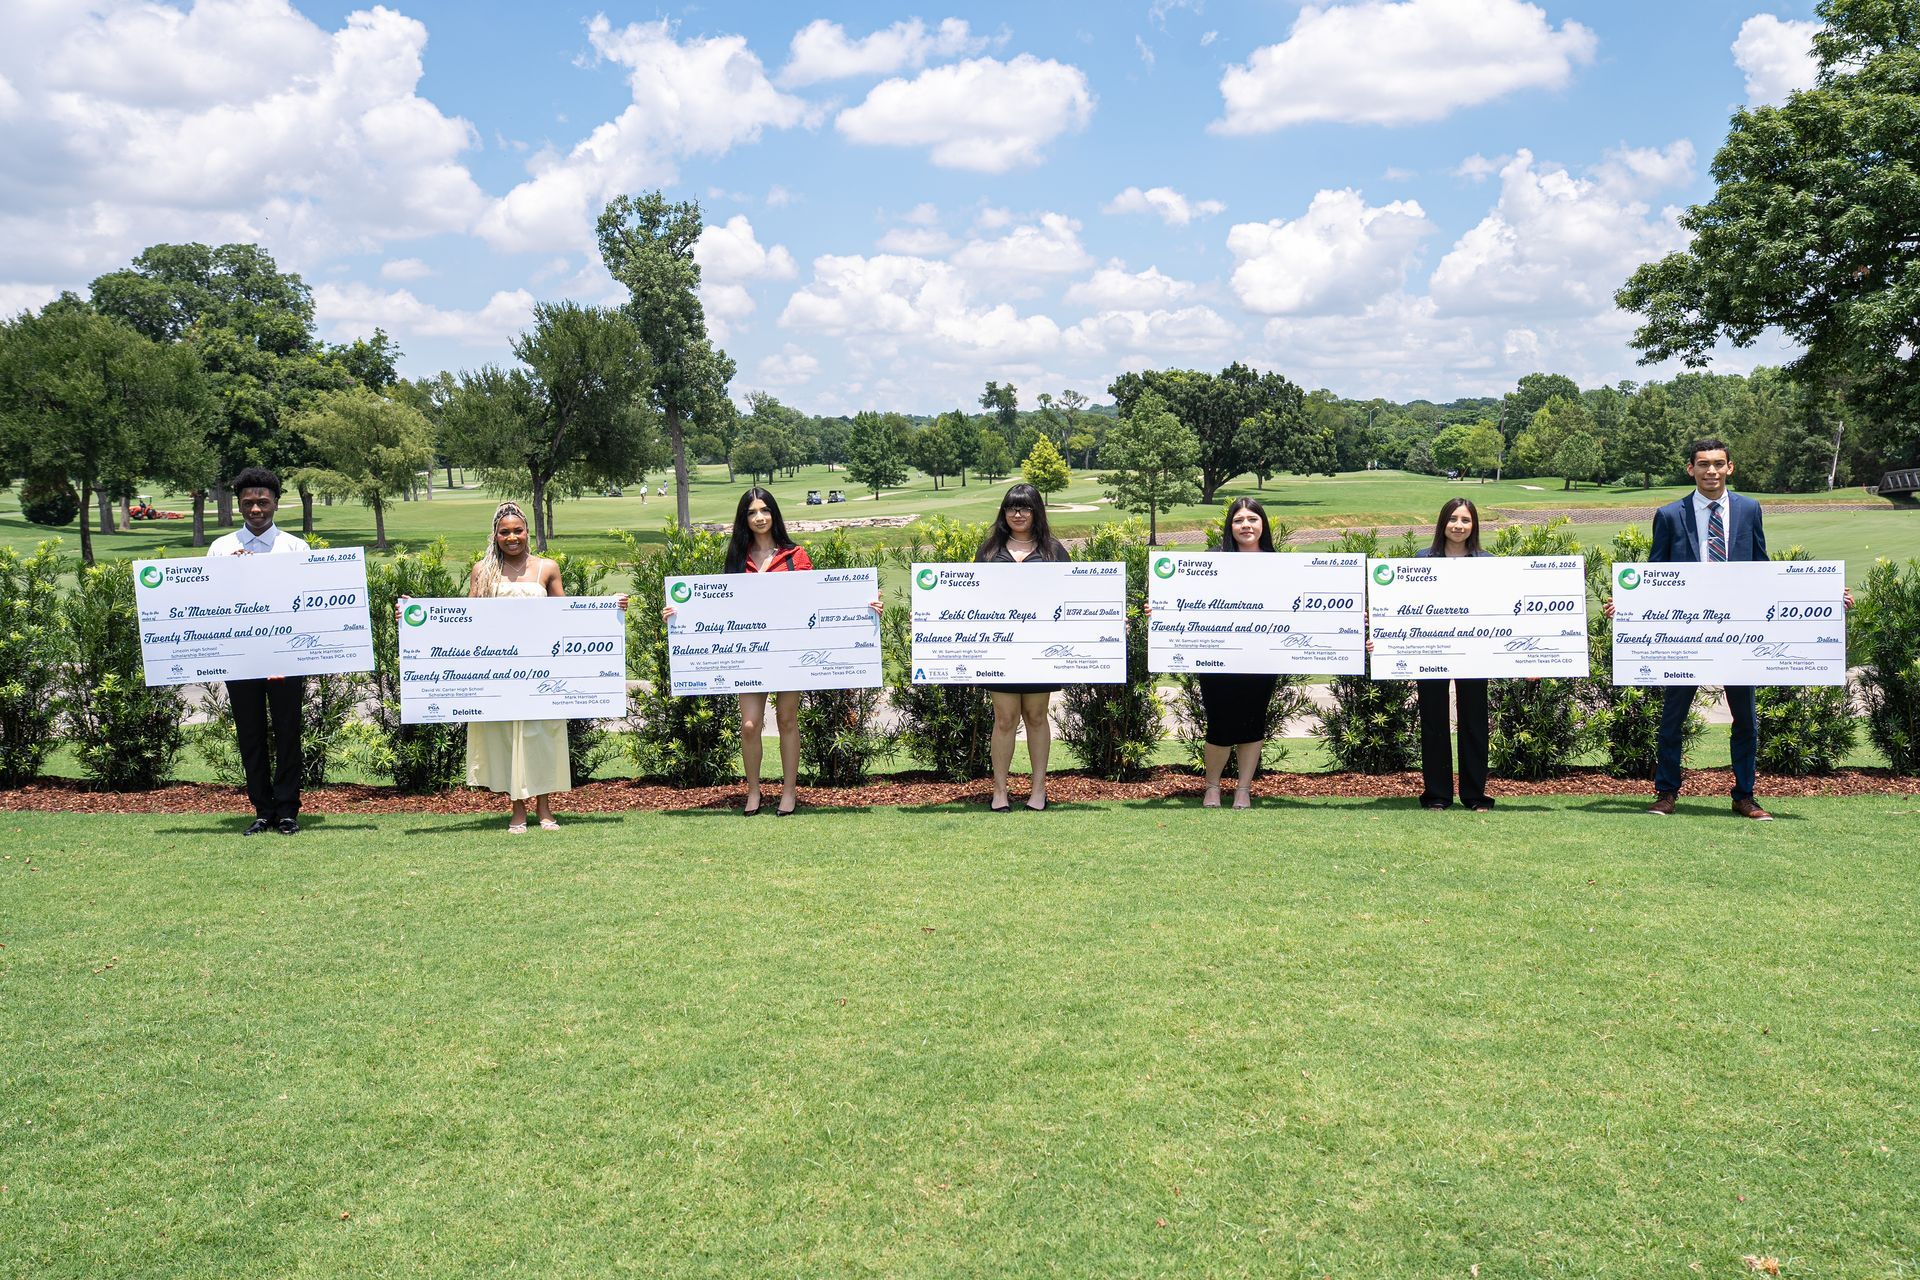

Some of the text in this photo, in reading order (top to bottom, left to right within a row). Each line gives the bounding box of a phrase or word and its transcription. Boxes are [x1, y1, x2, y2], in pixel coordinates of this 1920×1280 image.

[308, 553, 356, 563] June 16, 2026
[1312, 558, 1328, 566] June
[1178, 560, 1212, 569] Fairway
[166, 566, 202, 575] Fairway
[941, 571, 974, 580] Fairway
[1397, 566, 1431, 575] Fairway
[1643, 570, 1680, 579] Fairway
[175, 574, 210, 583] Success
[948, 579, 980, 587] Success
[1406, 574, 1437, 582] Success
[1652, 579, 1685, 587] Success
[694, 583, 727, 591] Fairway
[702, 591, 733, 599] Success
[292, 594, 355, 612] $ 20,000
[1177, 599, 1206, 611] Yvette
[1208, 599, 1264, 609] Altamirano
[1292, 597, 1353, 612] $ 20,000
[1513, 600, 1574, 616] $ 20,000
[169, 606, 232, 619] Sa'Mareion
[235, 602, 270, 613] Tucker
[430, 607, 466, 615] Fairway
[1053, 606, 1062, 621] $
[1397, 605, 1423, 615] Abril
[1426, 604, 1469, 614] Guerrero
[1766, 605, 1832, 621] $ 20,000
[439, 615, 472, 623] Success
[808, 613, 816, 629] $
[939, 610, 965, 620] Leibi
[967, 609, 1006, 620] Chavira
[1009, 610, 1037, 623] Reyes
[1642, 610, 1668, 620] Ariel
[1672, 610, 1700, 623] Meza
[1703, 609, 1730, 623] Meza
[695, 622, 724, 634] Daisy
[727, 620, 767, 631] Navarro
[1151, 621, 1290, 634] Twenty Thousand and 00/100
[144, 625, 292, 644] Twenty Thousand and 00/100
[915, 632, 1014, 642] Balance Paid In Full
[1373, 628, 1512, 640] Twenty Thousand and 00/100
[1616, 633, 1764, 646] Twenty Thousand and 00/100
[430, 646, 470, 657] Matisse
[473, 646, 518, 657] Edwards
[552, 641, 613, 657] $ 20,000
[672, 641, 769, 656] Balance Paid In Full
[403, 669, 549, 684] Twenty Thousand and 00/100
